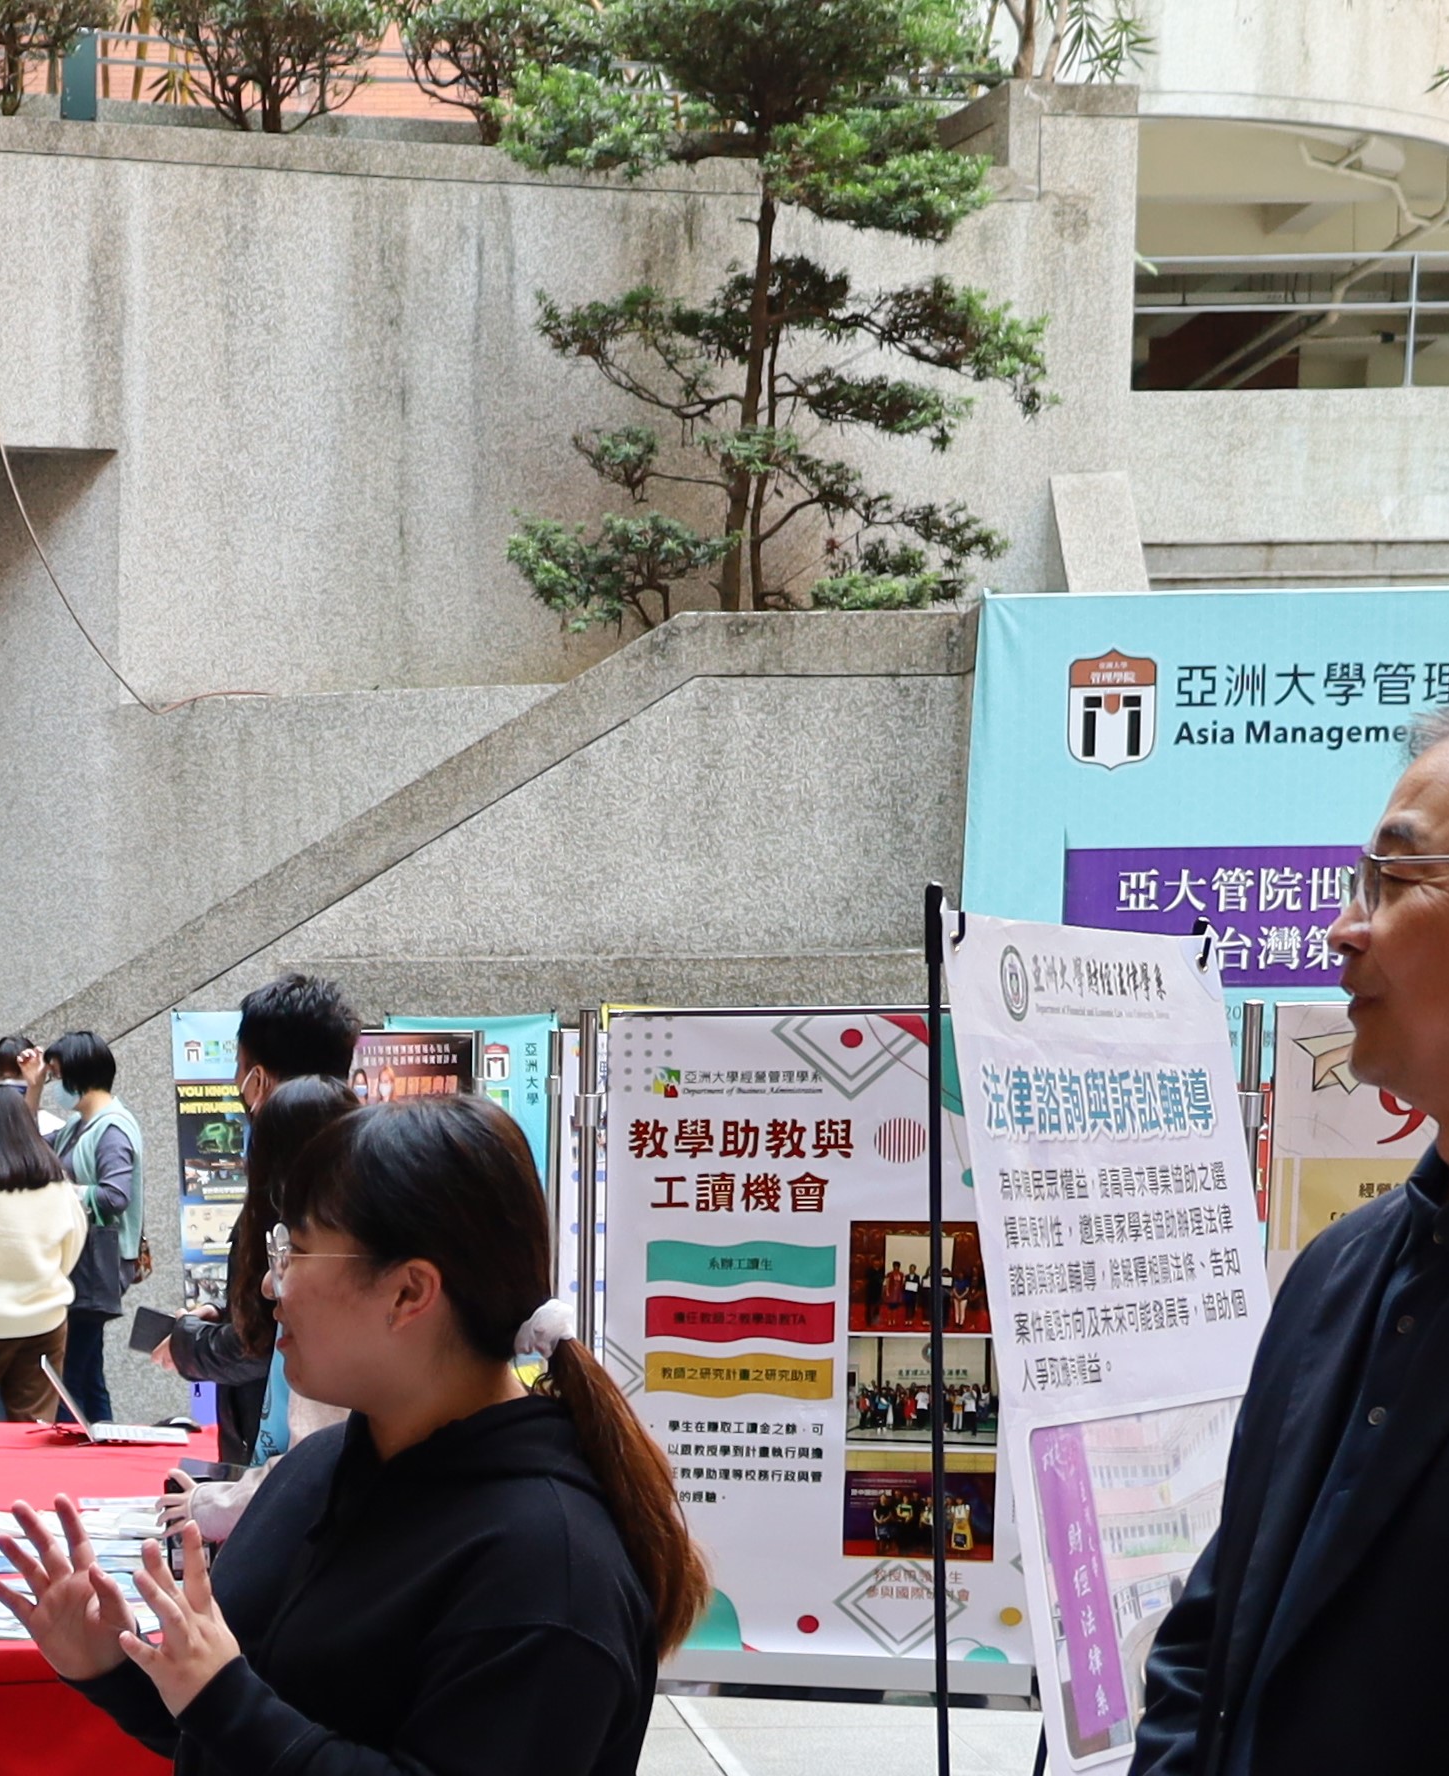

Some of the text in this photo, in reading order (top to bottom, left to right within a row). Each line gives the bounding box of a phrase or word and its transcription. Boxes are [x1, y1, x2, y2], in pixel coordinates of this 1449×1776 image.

[1175, 721, 1410, 752] Asia Manageme
[684, 1070, 823, 1084] 亞洲大學經營管理學系
[177, 1085, 203, 1097] YOU
[981, 1063, 1214, 1136] 法律諮詢與訴訟輔導
[628, 1118, 855, 1160] 教學助教與
[650, 1171, 830, 1213] 工讀機會
[1358, 1181, 1402, 1199] 經營
[675, 1490, 727, 1504] 的經驗。
